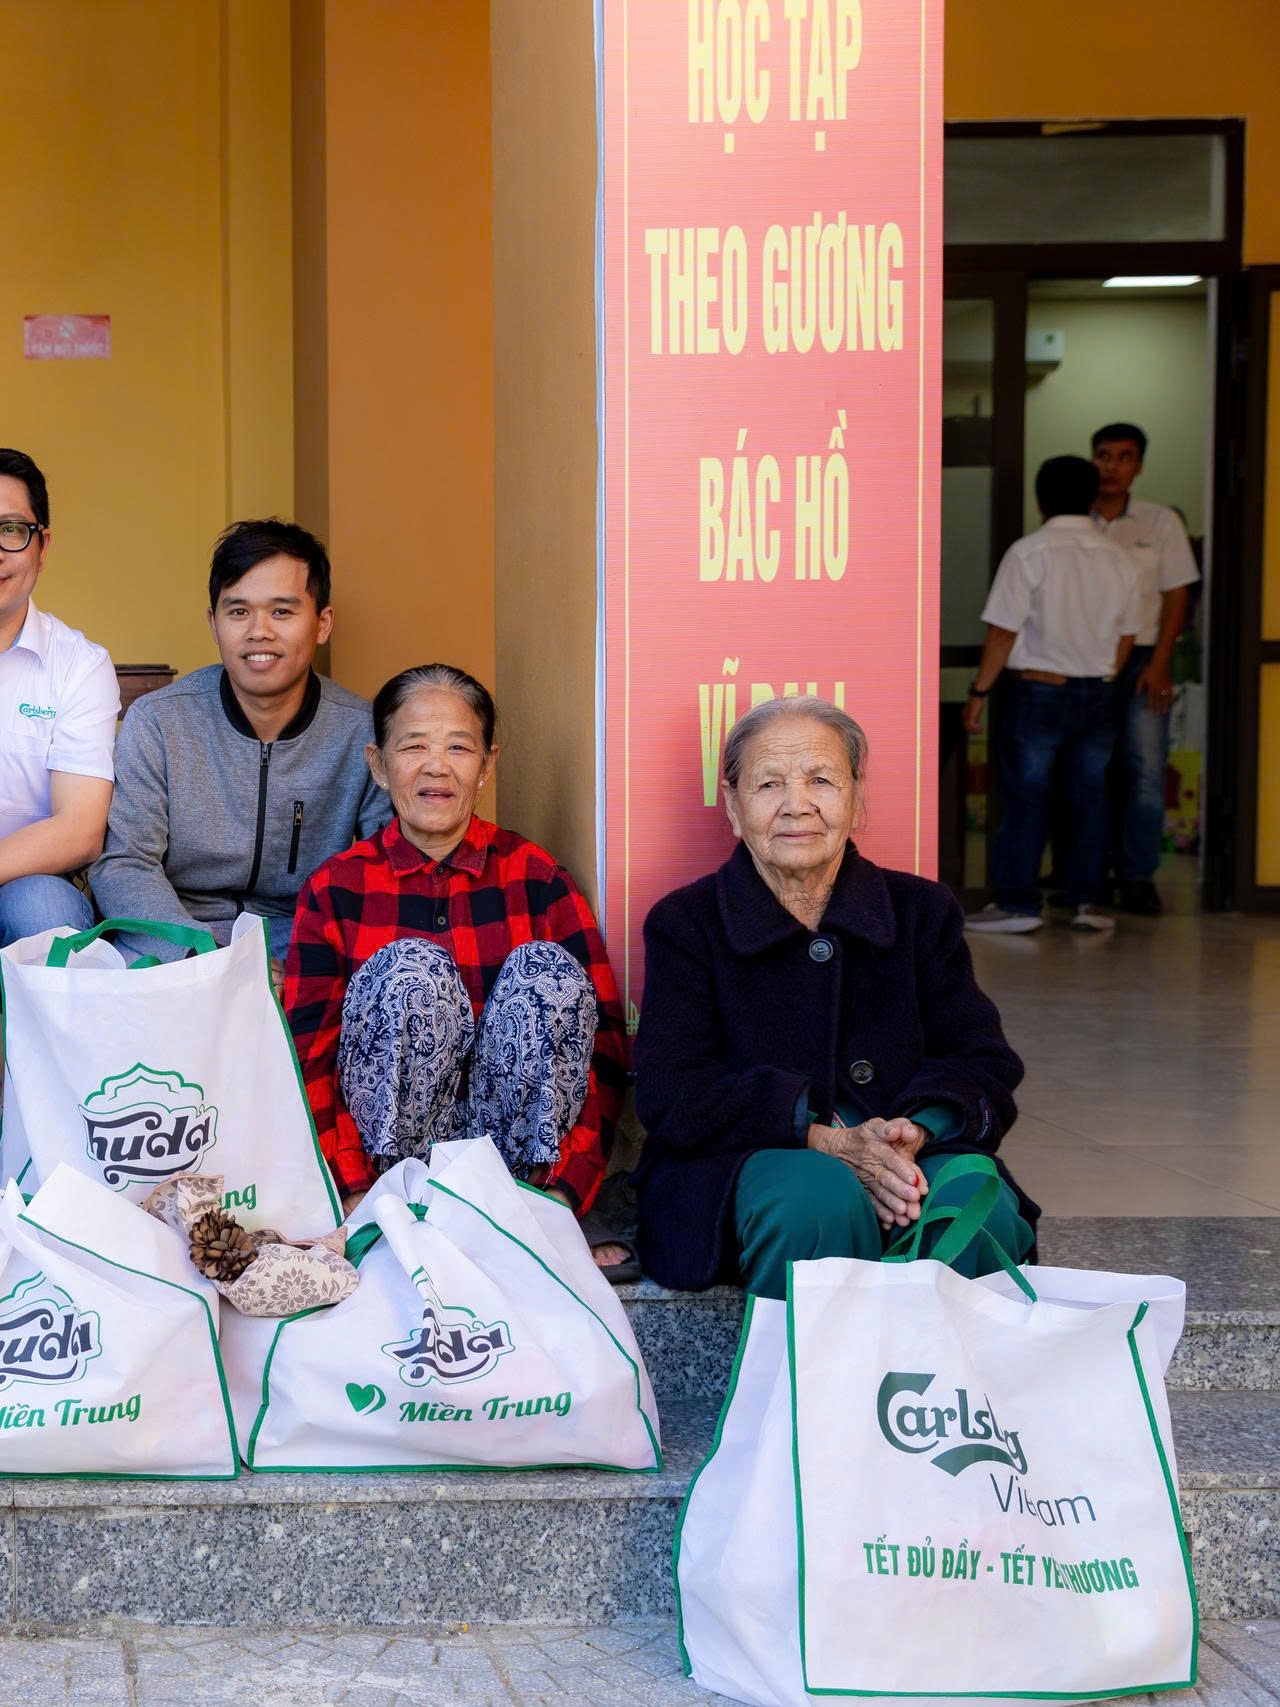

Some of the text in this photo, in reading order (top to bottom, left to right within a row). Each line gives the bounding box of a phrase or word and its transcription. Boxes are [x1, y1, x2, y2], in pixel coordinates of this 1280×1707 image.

[688, 0, 770, 153] HỌC
[645, 211, 904, 355] THEO GƯƠNG
[699, 409, 850, 582] BÁC HỒ
[19, 703, 56, 719] Carlsberg
[54, 1393, 141, 1427] Trung
[399, 1391, 572, 1423] Miền Trung
[863, 1534, 900, 1576] TẾT
[907, 1535, 936, 1578] ĐỦ
[942, 1538, 981, 1580] ĐẦY
[1000, 1544, 1036, 1586] TẾT
